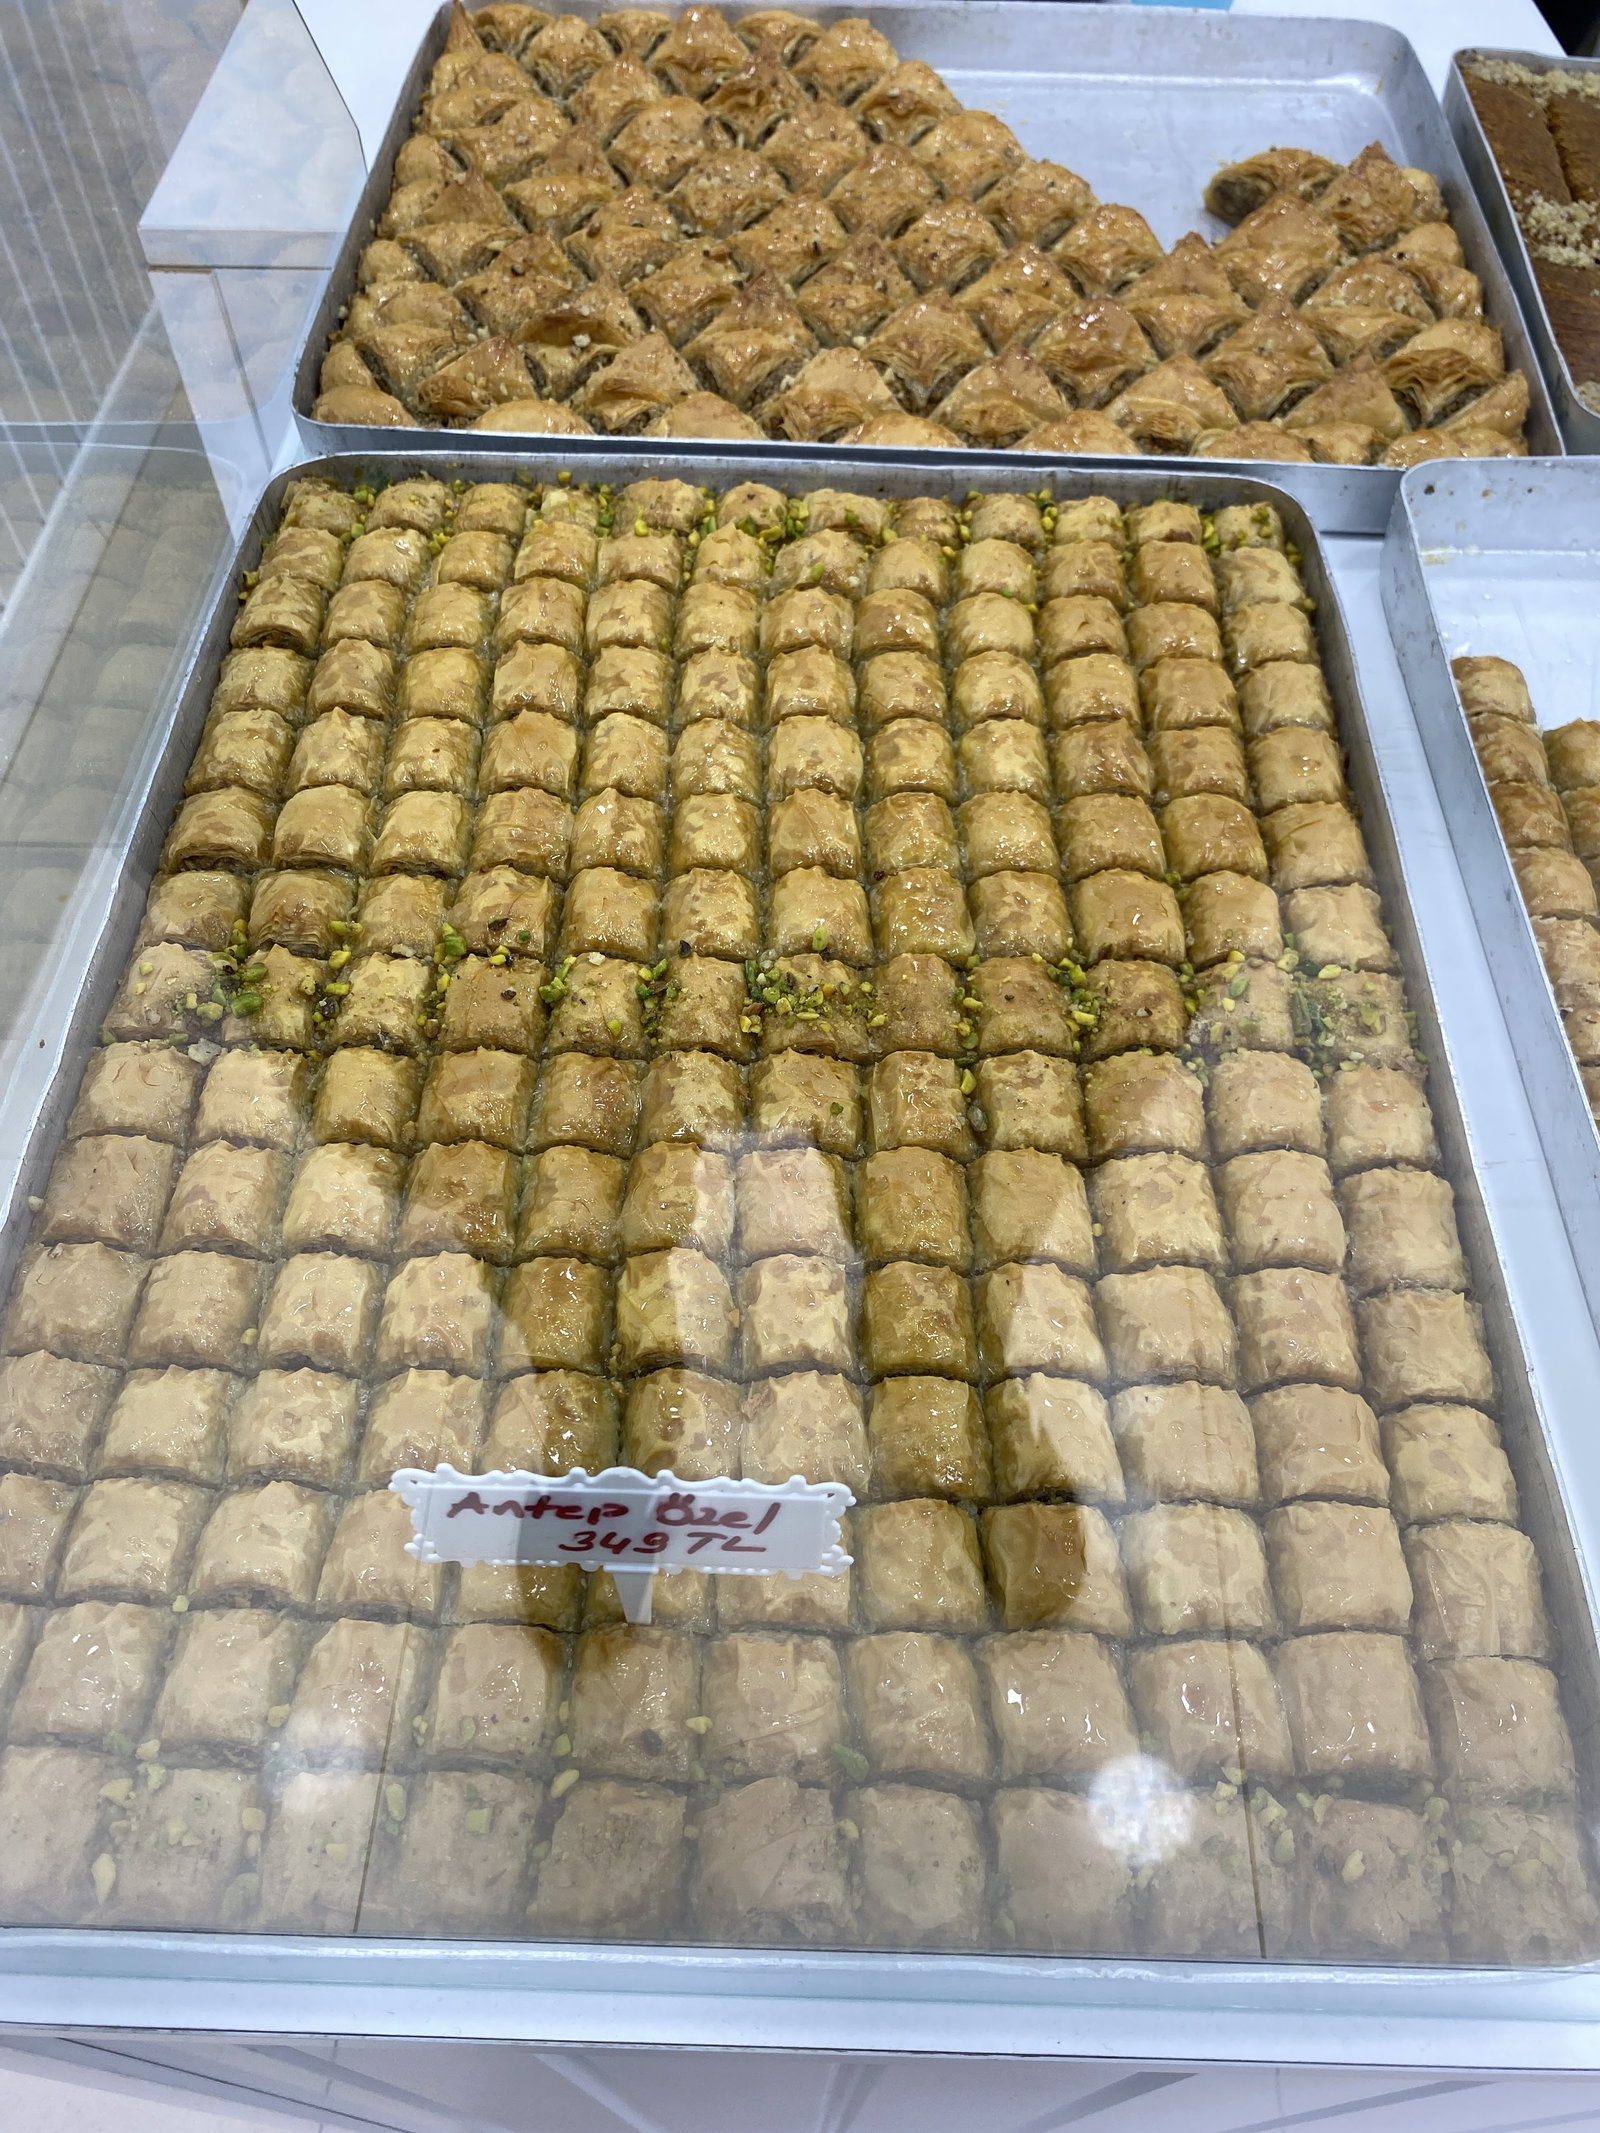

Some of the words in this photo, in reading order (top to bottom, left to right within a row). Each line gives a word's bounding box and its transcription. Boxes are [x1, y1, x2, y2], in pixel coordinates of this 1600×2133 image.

[447, 1492, 629, 1526] Antep
[656, 1492, 782, 1535] Özel
[558, 1531, 669, 1555] 349
[686, 1532, 767, 1555] TL
